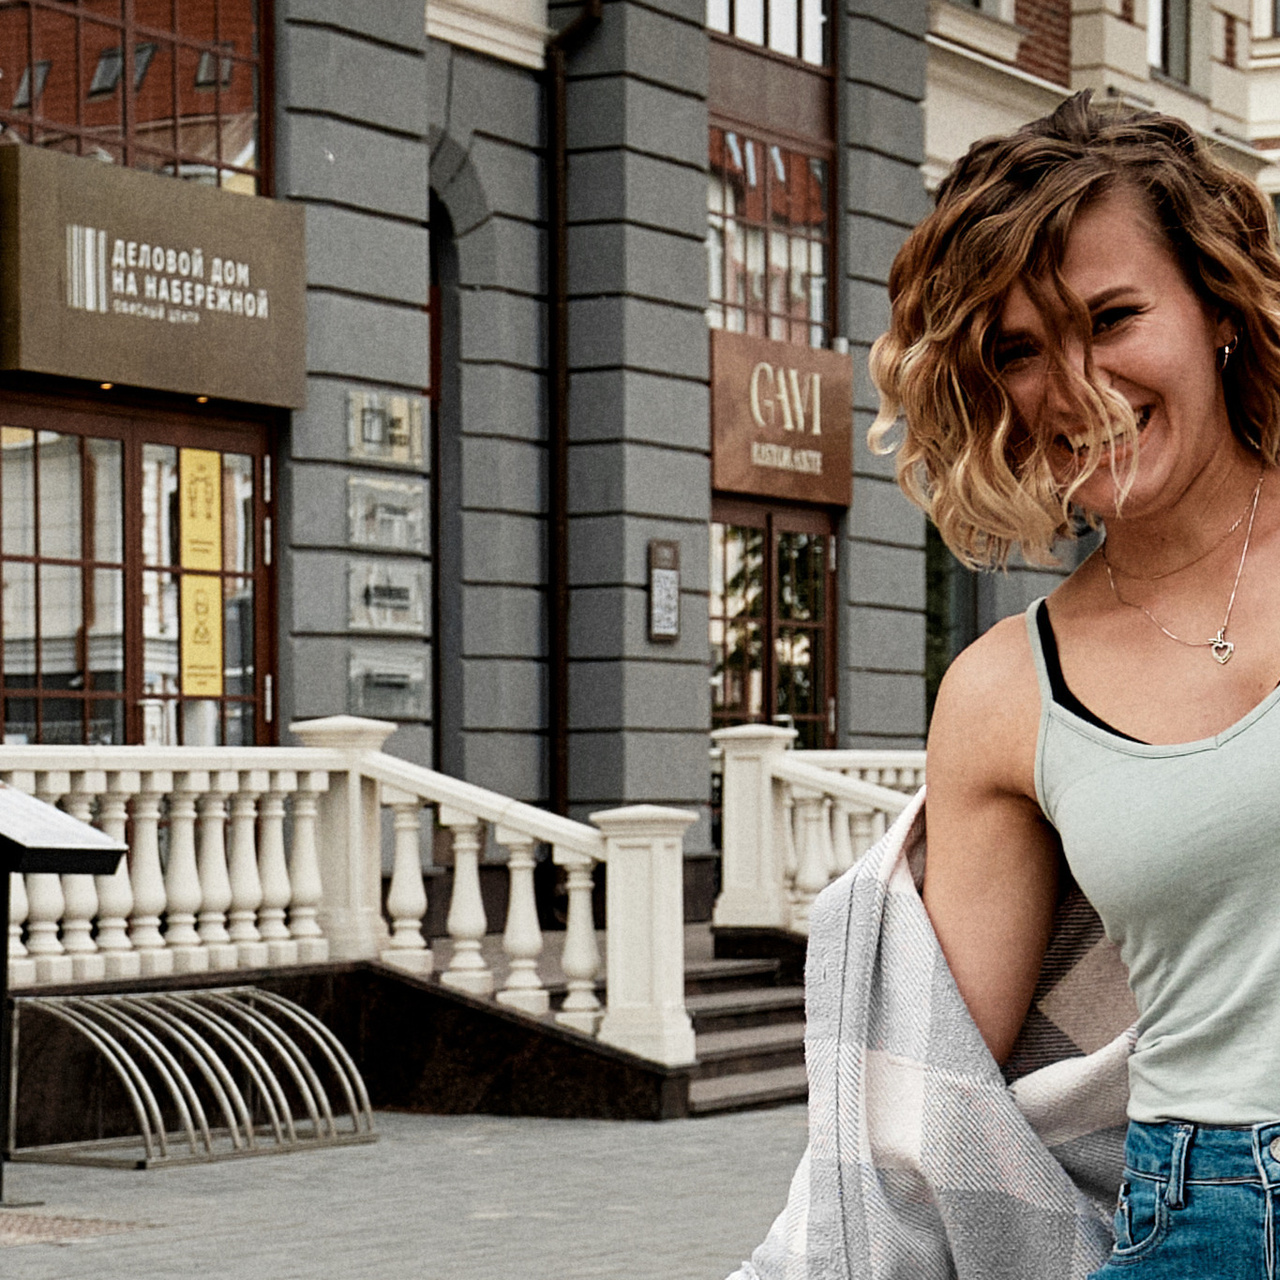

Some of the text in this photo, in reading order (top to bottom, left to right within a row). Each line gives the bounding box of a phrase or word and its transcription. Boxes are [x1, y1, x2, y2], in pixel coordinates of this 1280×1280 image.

[111, 239, 250, 288] ДЕЛОВОЙ ДОМ
[111, 269, 269, 319] НА НАБЕРЕЖНОЙ
[750, 361, 822, 436] GAVI
